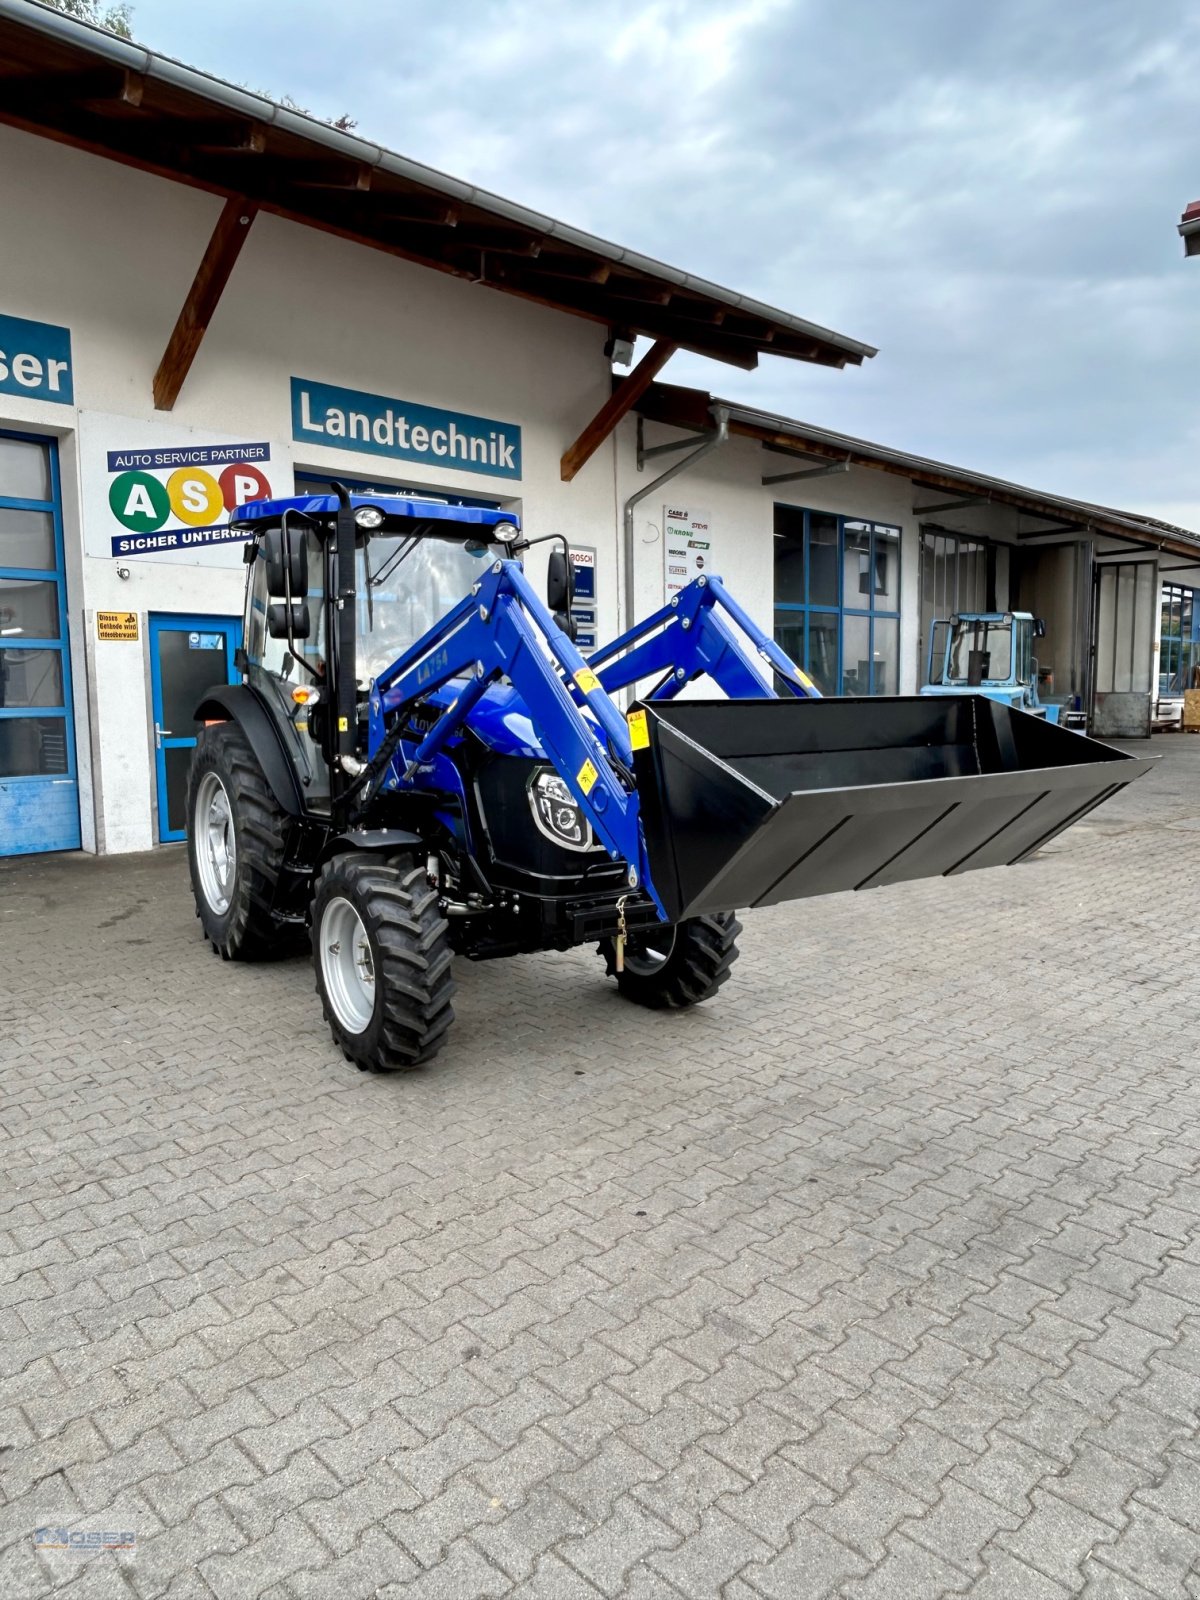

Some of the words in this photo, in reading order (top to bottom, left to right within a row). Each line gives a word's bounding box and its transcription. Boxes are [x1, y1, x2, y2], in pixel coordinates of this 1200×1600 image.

[301, 391, 516, 469] Landtechnik
[115, 455, 152, 467] AUTO
[155, 451, 208, 464] SERVICE
[211, 447, 264, 460] PARTNER
[119, 535, 178, 551] SICHER
[570, 553, 593, 564] BOSCH
